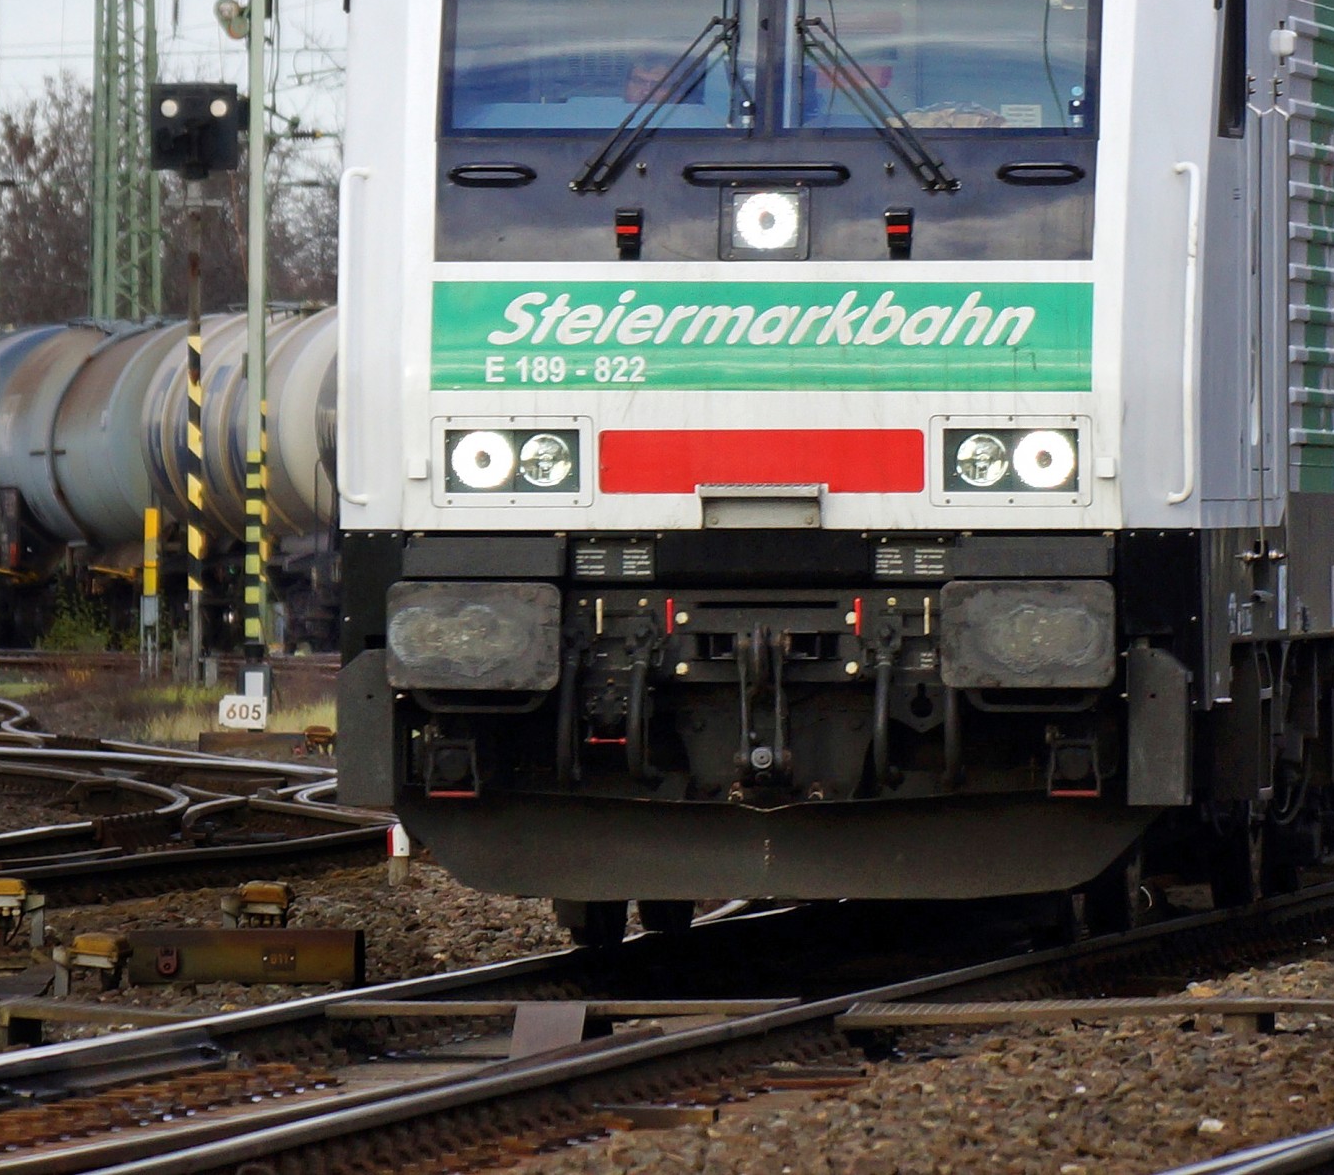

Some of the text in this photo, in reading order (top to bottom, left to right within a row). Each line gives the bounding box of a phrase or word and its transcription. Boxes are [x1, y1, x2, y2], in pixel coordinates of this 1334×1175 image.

[487, 289, 1036, 346] Steiermarkbahn
[485, 356, 505, 382] E
[515, 356, 566, 382] 189
[594, 356, 646, 382] 822
[226, 704, 262, 720] 605
